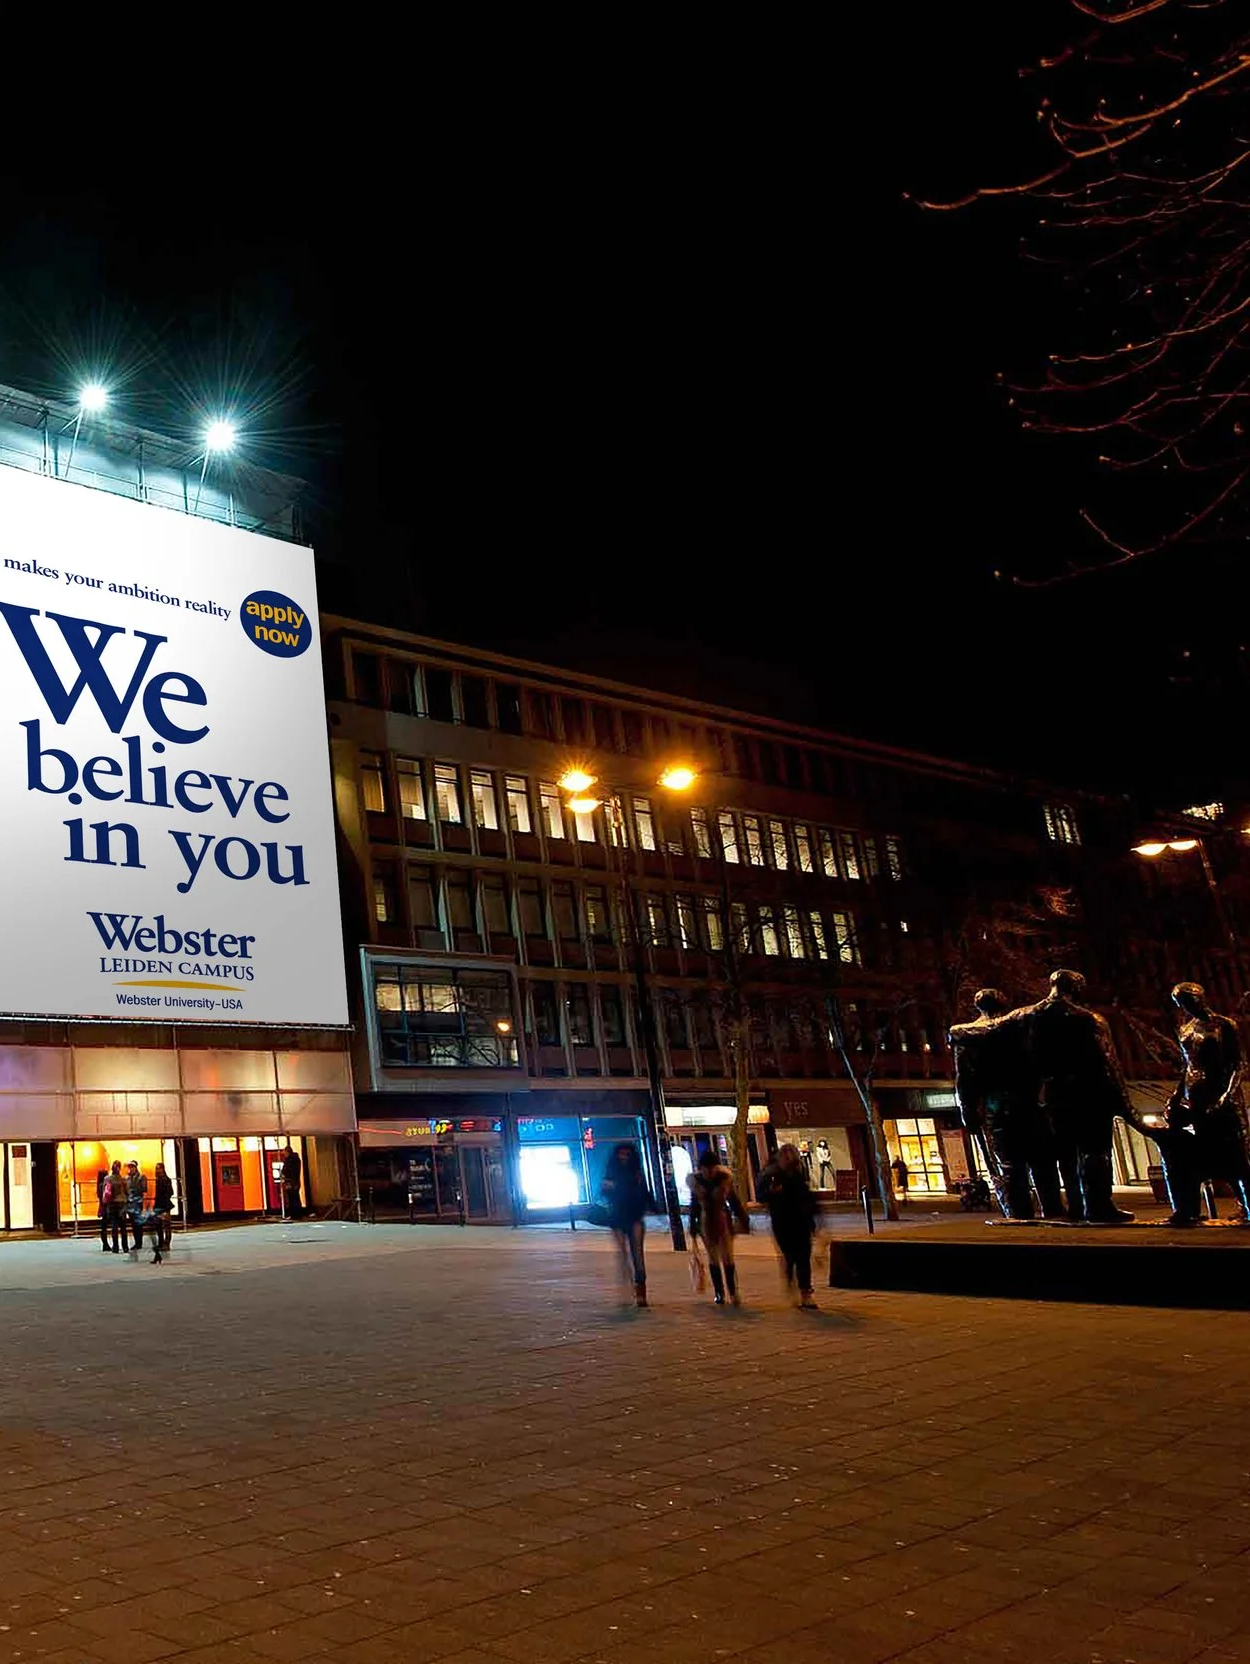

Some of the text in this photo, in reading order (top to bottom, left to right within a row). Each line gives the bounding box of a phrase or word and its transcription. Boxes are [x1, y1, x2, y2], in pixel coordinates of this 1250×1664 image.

[3, 557, 59, 579] makes
[63, 571, 104, 589] your
[108, 579, 181, 607] ambition
[184, 597, 232, 621] reality
[246, 600, 304, 629] apply
[254, 625, 299, 647] now
[19, 718, 291, 823] believe
[62, 791, 310, 893] in you
[86, 911, 256, 958] Webster
[100, 957, 254, 981] LEIDEN CAMPUS
[116, 993, 161, 1007] Webster
[782, 1101, 809, 1124] yes
